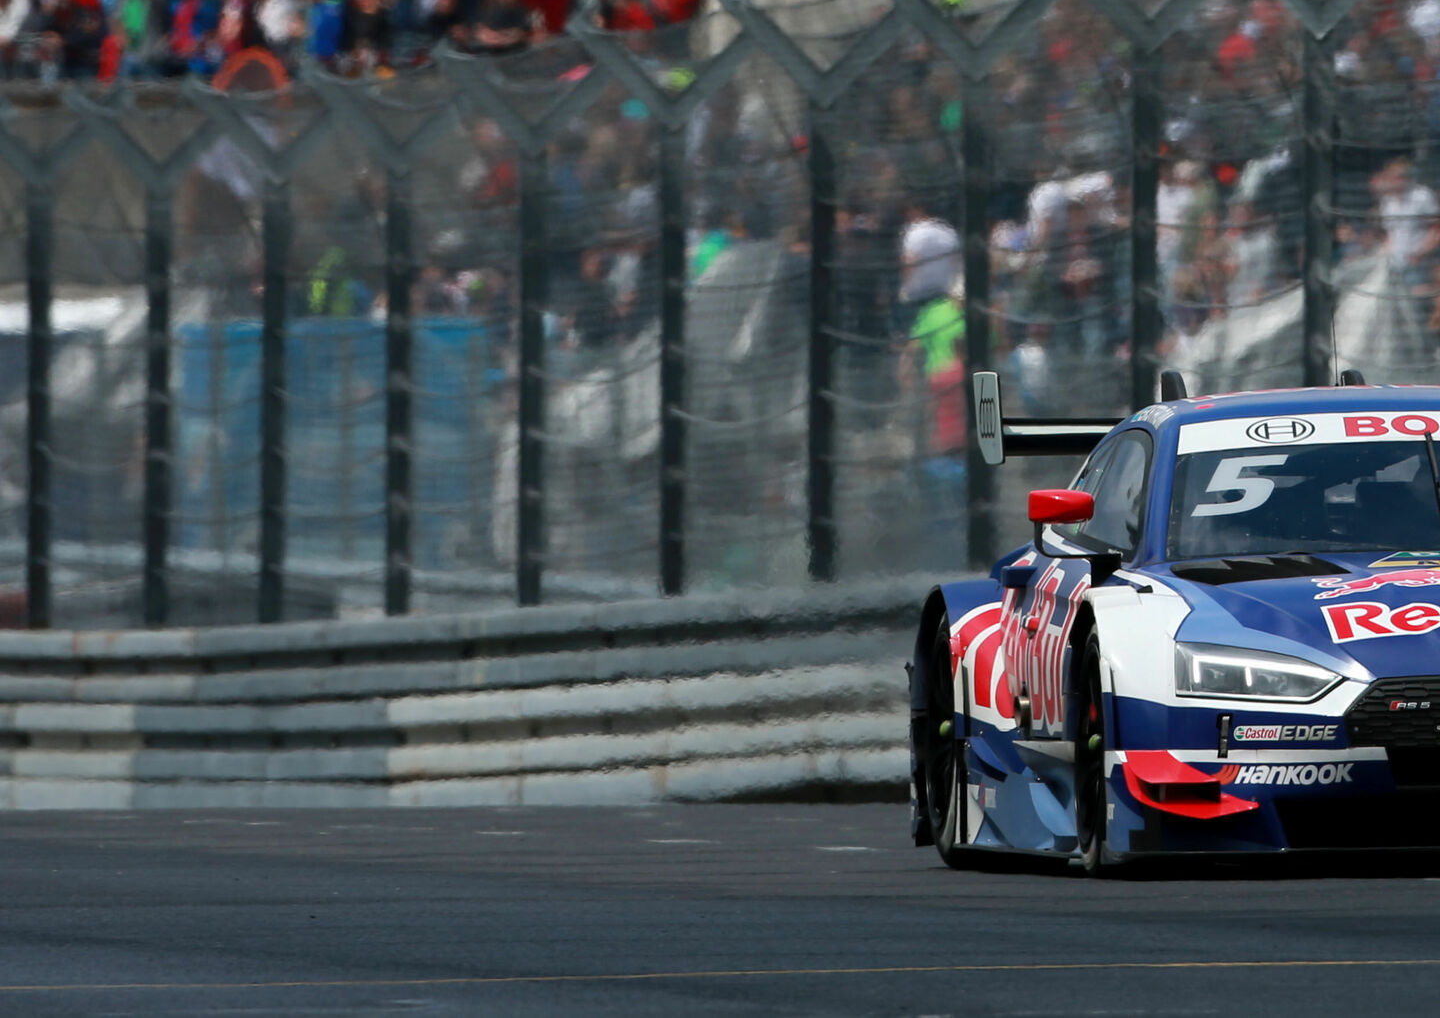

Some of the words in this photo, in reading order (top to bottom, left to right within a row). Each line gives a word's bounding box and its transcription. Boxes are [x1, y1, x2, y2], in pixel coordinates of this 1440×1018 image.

[1191, 454, 1289, 517] 5
[1245, 726, 1279, 740] Castrol
[1279, 725, 1339, 741] EDGE
